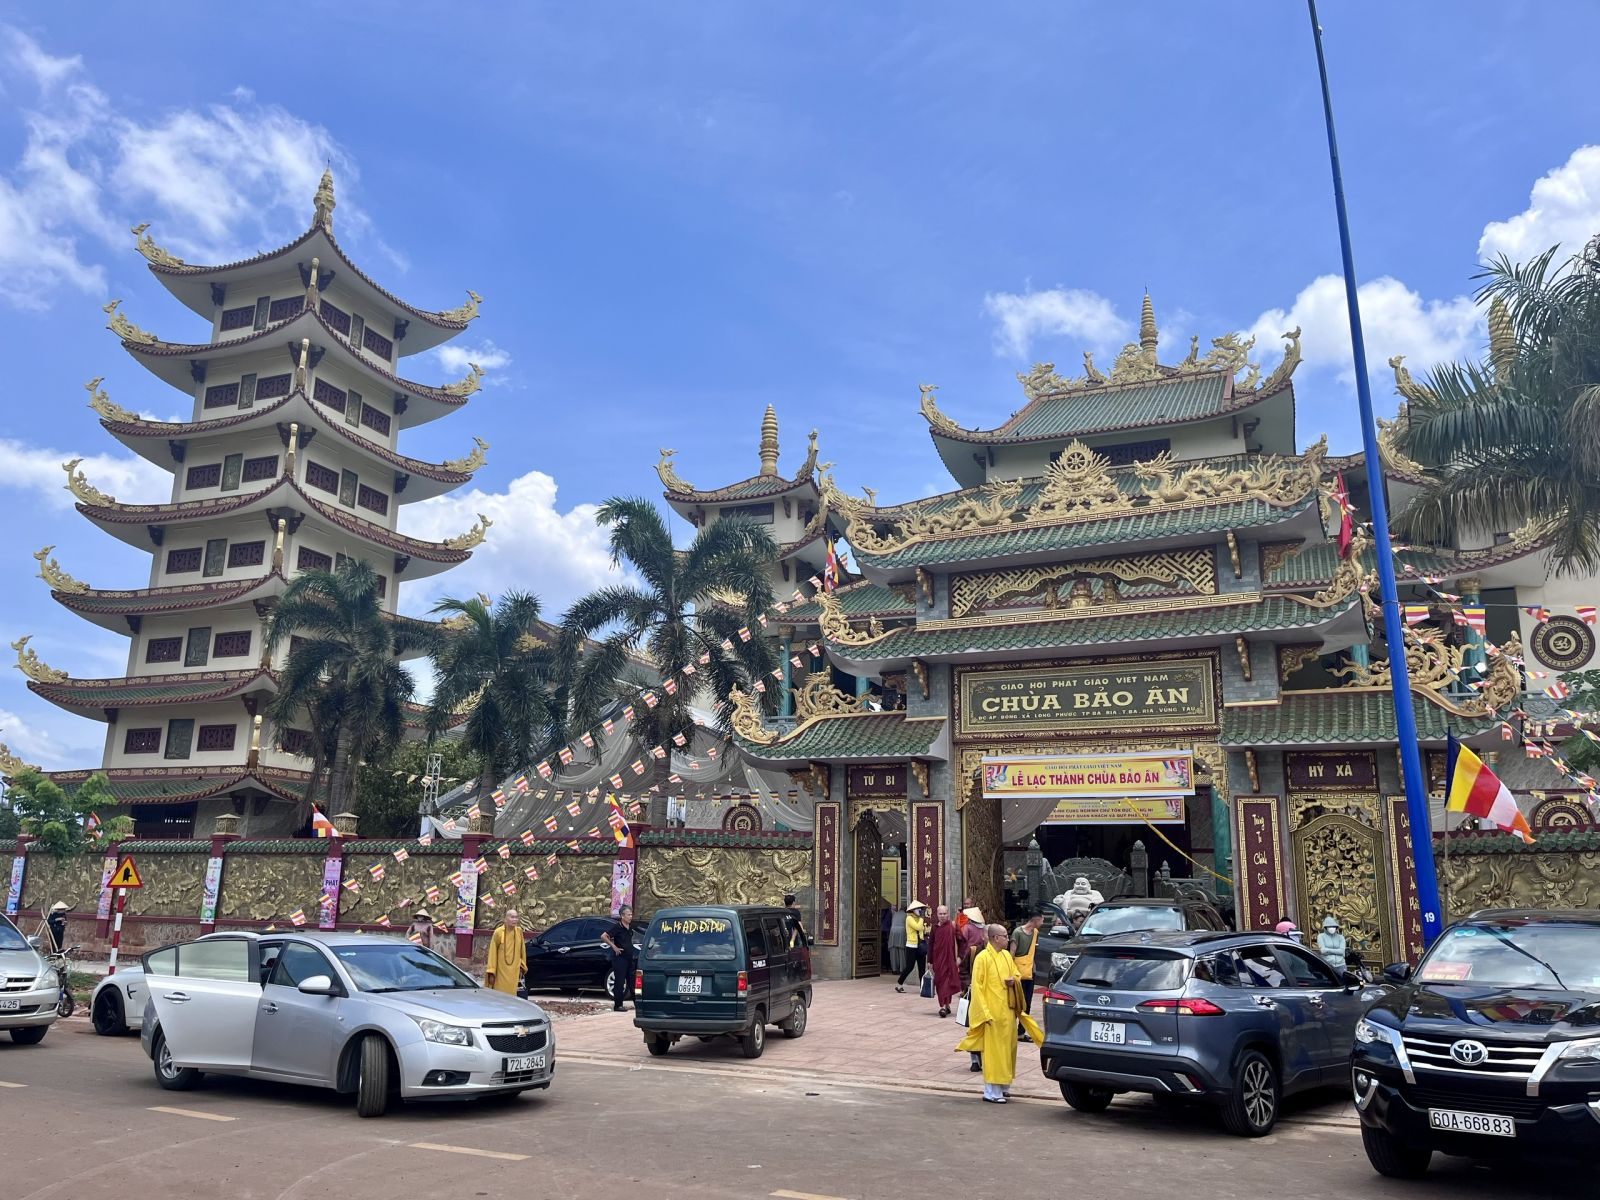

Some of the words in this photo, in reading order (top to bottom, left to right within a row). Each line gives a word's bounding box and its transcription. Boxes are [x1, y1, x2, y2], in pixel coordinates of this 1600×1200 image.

[1144, 674, 1169, 682] NAM
[982, 690, 1061, 713] CHÙA
[1073, 686, 1134, 709] BẢO
[1145, 685, 1189, 705] ÂN
[1335, 760, 1353, 777] XẢ
[885, 775, 895, 786] BI
[1012, 769, 1024, 786] LỄ
[1027, 774, 1046, 789] LẠC
[1049, 771, 1085, 786] THÀNH
[1087, 769, 1117, 785] CHÙA
[1120, 768, 1141, 784] BẢO
[1144, 769, 1160, 783] ÂN
[1424, 912, 1436, 923] 19
[683, 976, 696, 984] 72A
[1100, 1023, 1115, 1032] 72A
[1094, 1032, 1120, 1042] 649.18
[510, 1056, 544, 1071] 72L-2845
[1432, 1111, 1511, 1134] 60A-668.83
